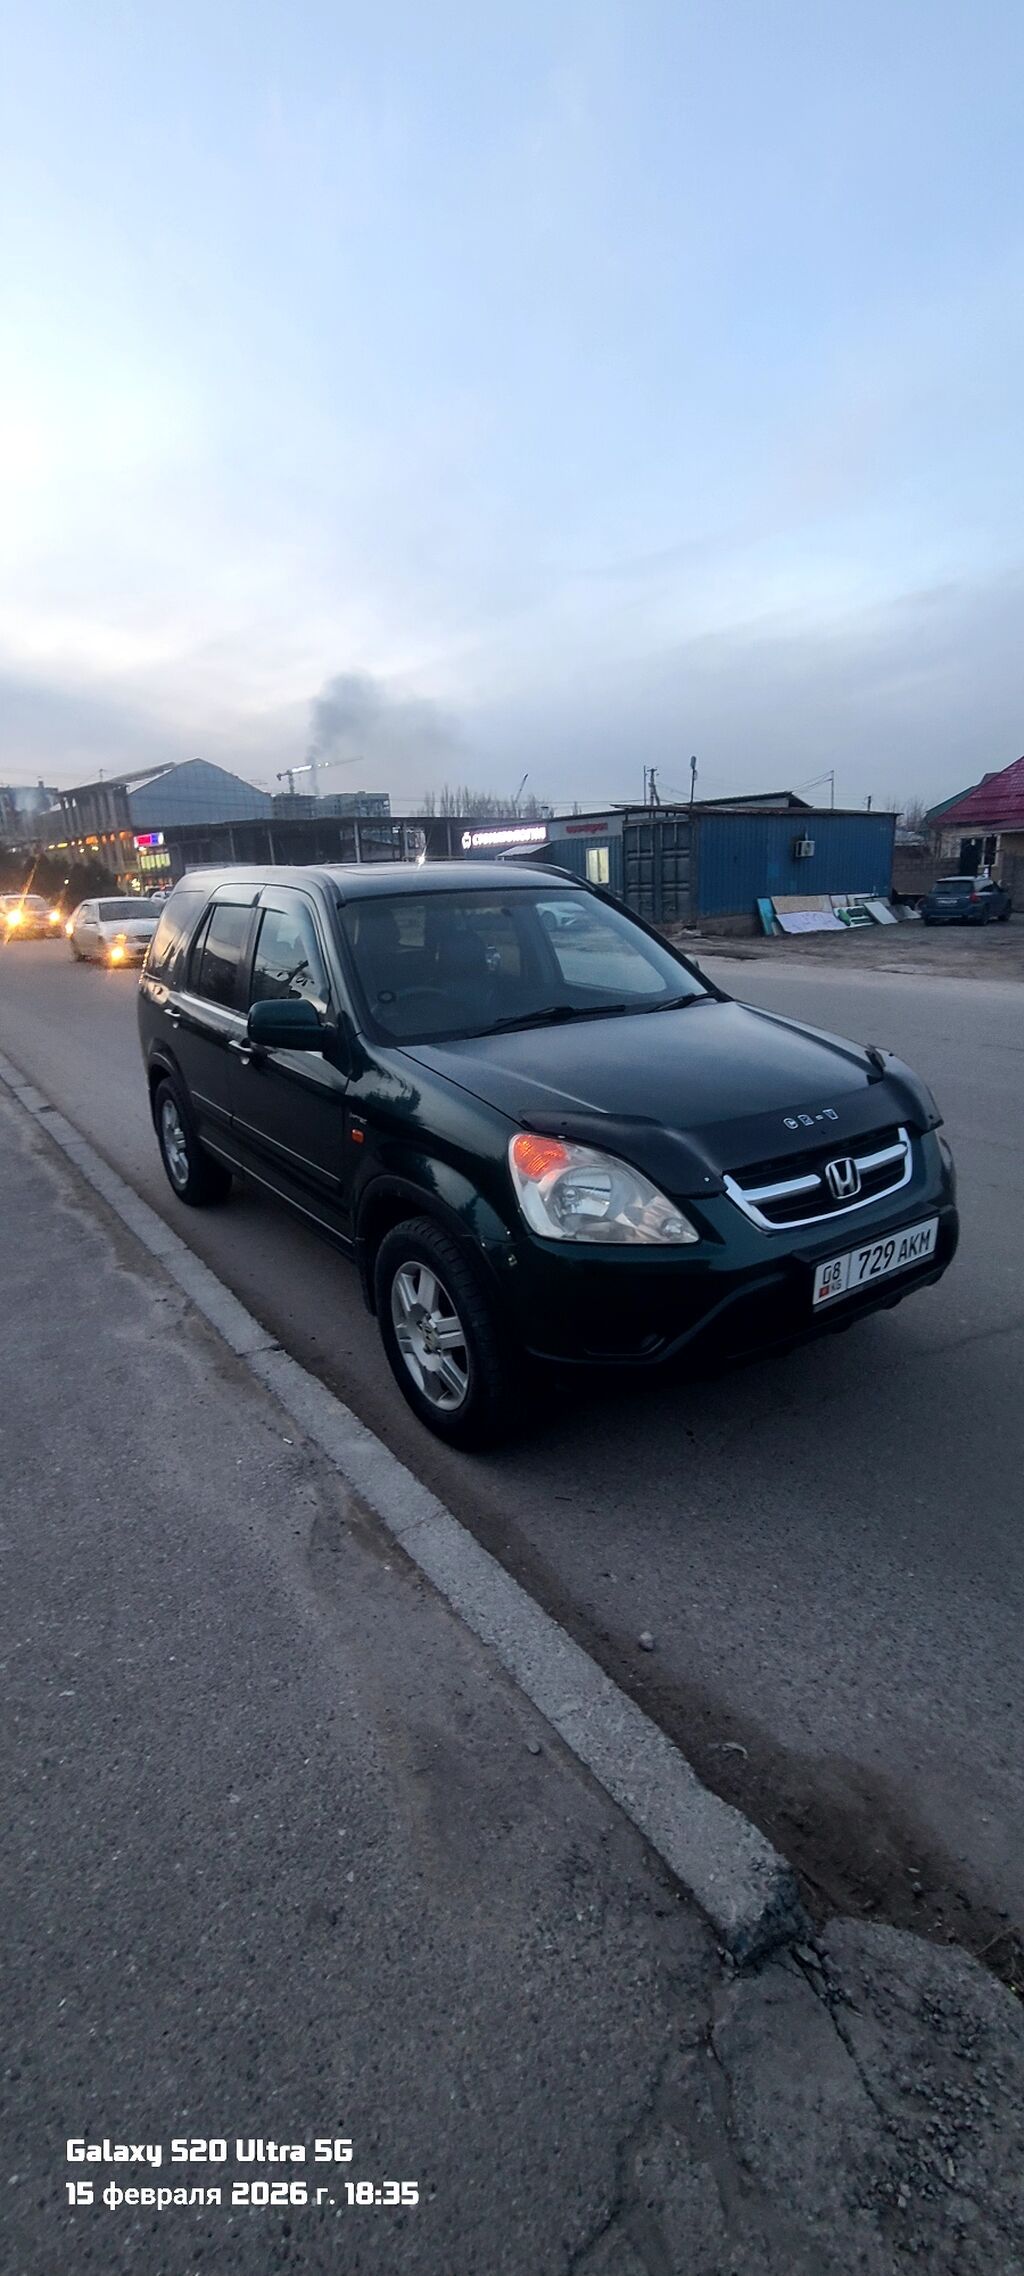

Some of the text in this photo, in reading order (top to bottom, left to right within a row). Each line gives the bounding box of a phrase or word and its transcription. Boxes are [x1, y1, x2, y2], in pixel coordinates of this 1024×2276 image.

[822, 1229, 931, 1285] 08 729 AKM
[831, 1279, 842, 1291] KG
